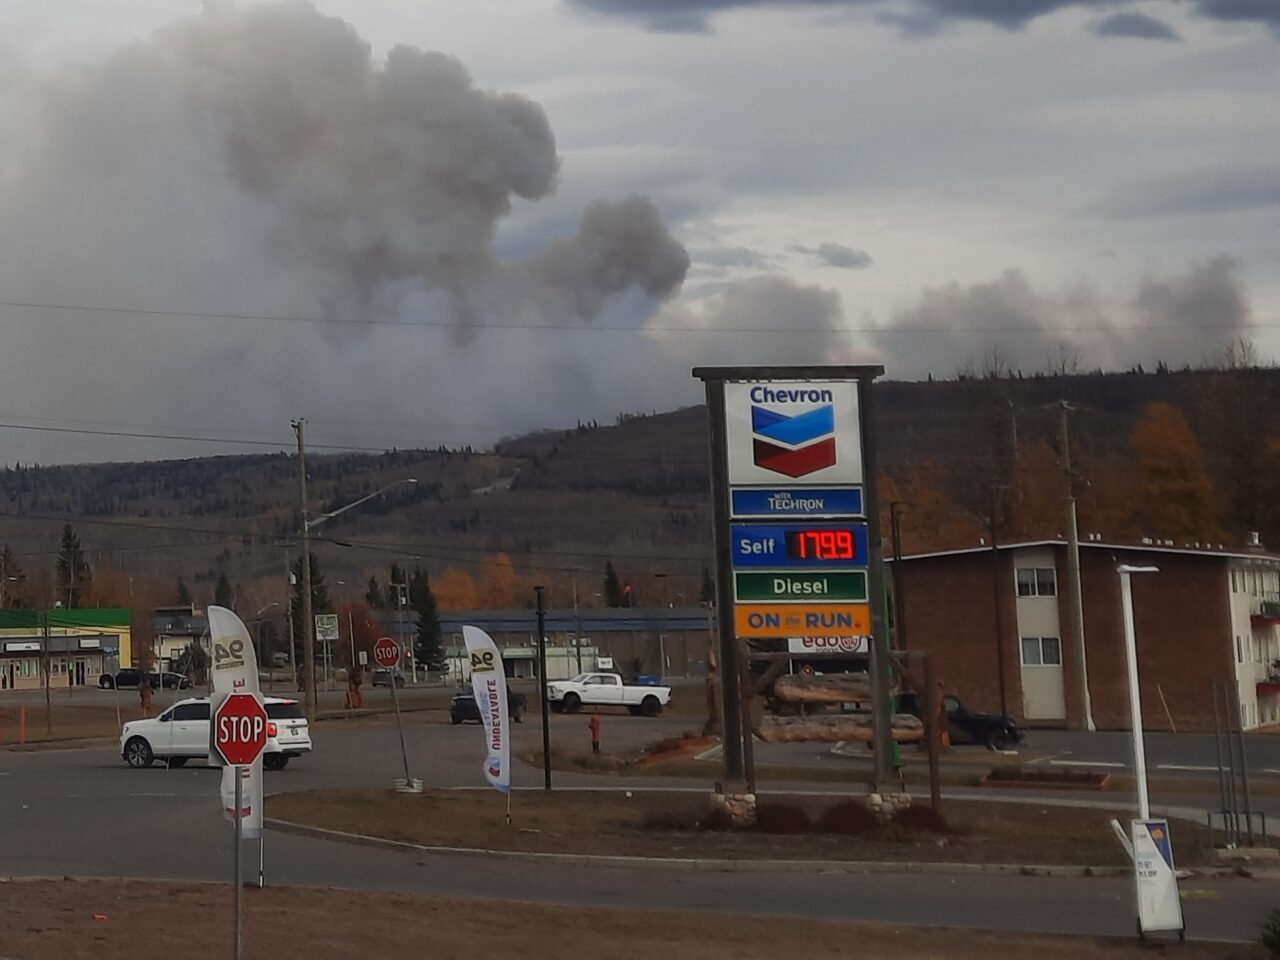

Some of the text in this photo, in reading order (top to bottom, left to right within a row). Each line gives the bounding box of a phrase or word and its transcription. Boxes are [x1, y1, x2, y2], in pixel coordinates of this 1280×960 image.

[750, 385, 833, 404] Chevron
[768, 498, 825, 512] TECHRON
[740, 538, 775, 555] Self
[773, 578, 828, 594] Diesel
[747, 613, 781, 629] ON
[805, 613, 852, 629] RUN
[376, 646, 398, 660] STOP
[220, 716, 263, 743] STOP
